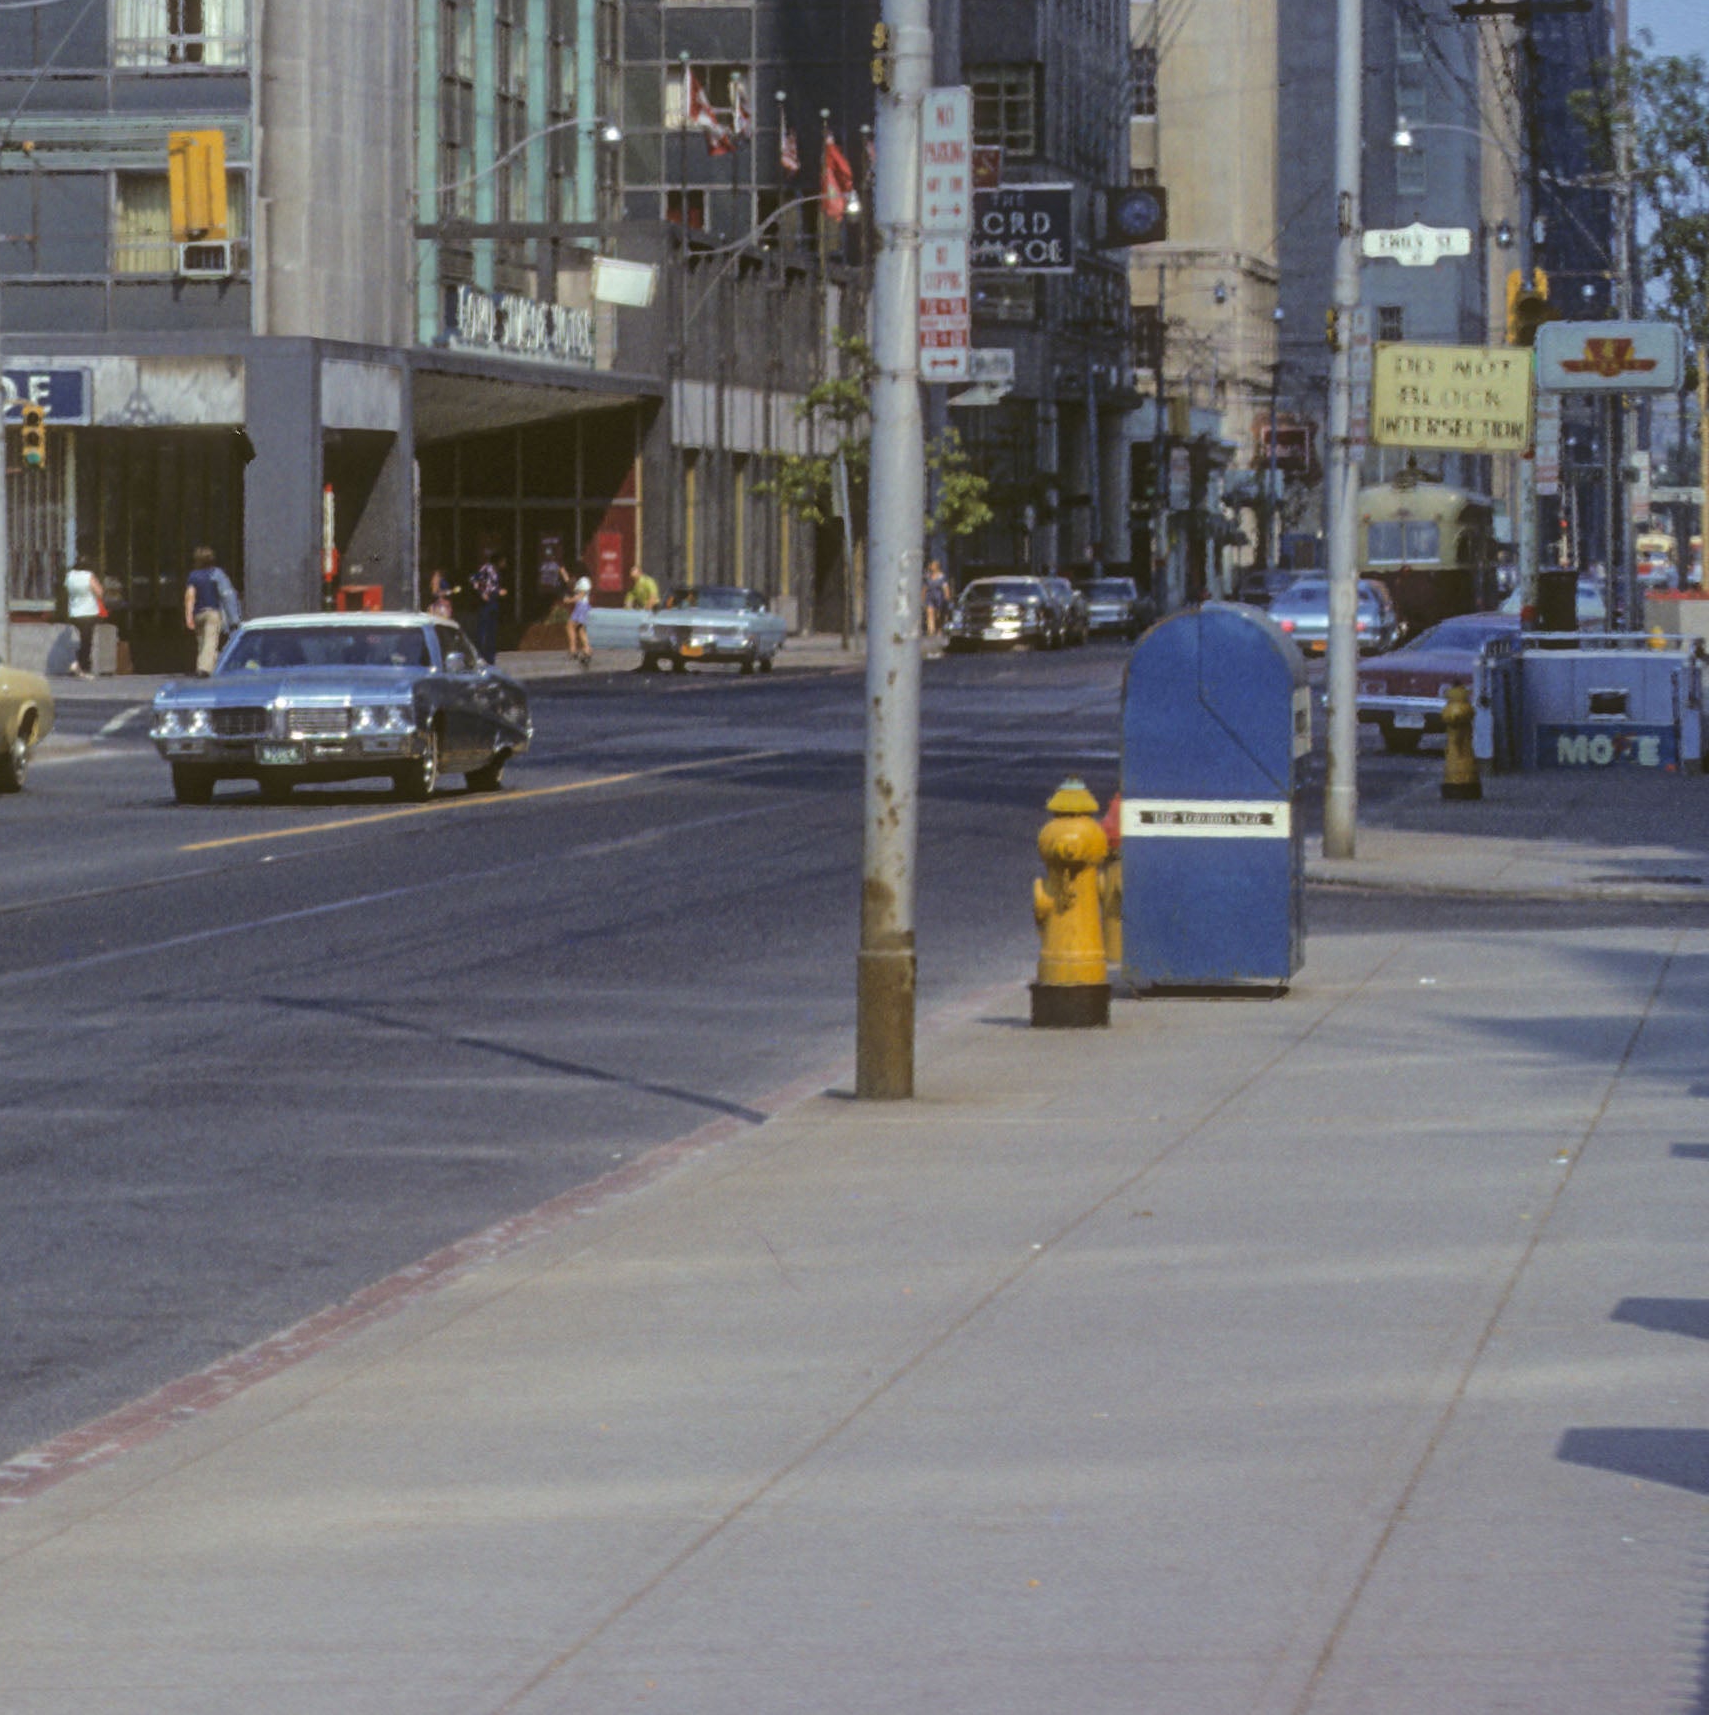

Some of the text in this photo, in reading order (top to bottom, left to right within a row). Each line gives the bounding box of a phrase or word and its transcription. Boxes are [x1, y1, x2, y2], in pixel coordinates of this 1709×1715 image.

[936, 106, 954, 125] NO
[1399, 386, 1500, 408] BLOCK
[1557, 734, 1660, 766] MOE
